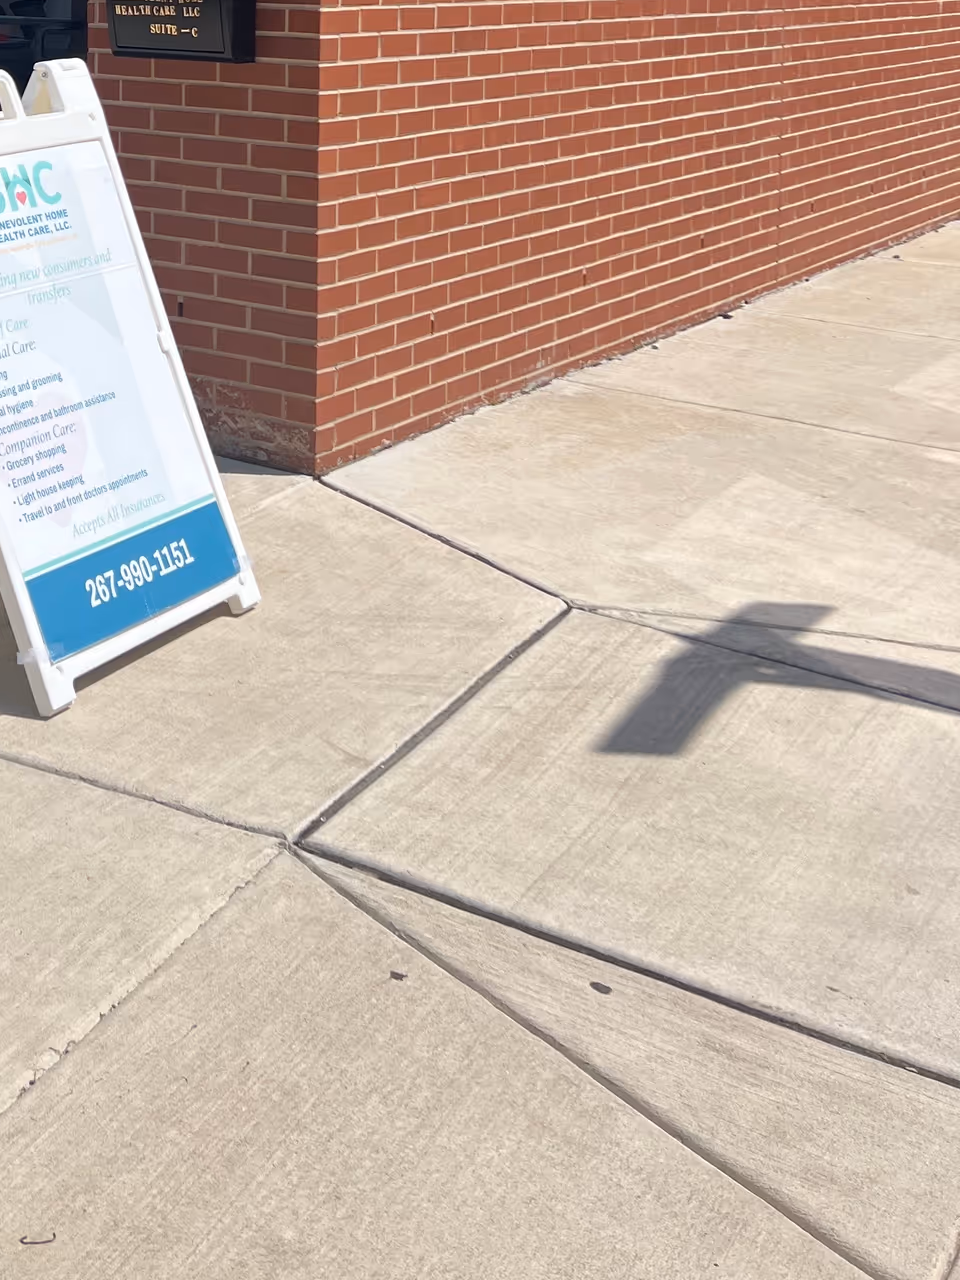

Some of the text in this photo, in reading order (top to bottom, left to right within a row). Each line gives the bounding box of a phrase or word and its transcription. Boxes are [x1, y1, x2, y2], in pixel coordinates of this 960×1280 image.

[115, 4, 200, 17] HEALTH CARE LLC
[150, 23, 178, 35] SUITE
[44, 208, 69, 222] HOME
[27, 224, 54, 237] CARE,
[54, 220, 72, 232] LLC.
[19, 264, 41, 281] new
[41, 253, 94, 277] consumers
[94, 247, 113, 266] and
[11, 340, 37, 356] Care:
[17, 379, 31, 393] and
[31, 371, 63, 391] grooming
[6, 399, 34, 416] hygiene
[40, 408, 53, 423] and
[53, 401, 84, 418] bathroom
[84, 390, 117, 408] assistance
[52, 422, 77, 439] Care:
[6, 442, 67, 470] Grocery shopping
[12, 463, 65, 489] Errand services
[16, 473, 85, 506] Light house keeping
[22, 506, 45, 523] Travel
[45, 504, 54, 518] to
[54, 498, 67, 513] and
[83, 483, 108, 500] doctors
[108, 469, 148, 491] appointments
[72, 514, 106, 538] Accepts
[106, 504, 120, 523] All
[85, 537, 195, 608] 267-990-1151
